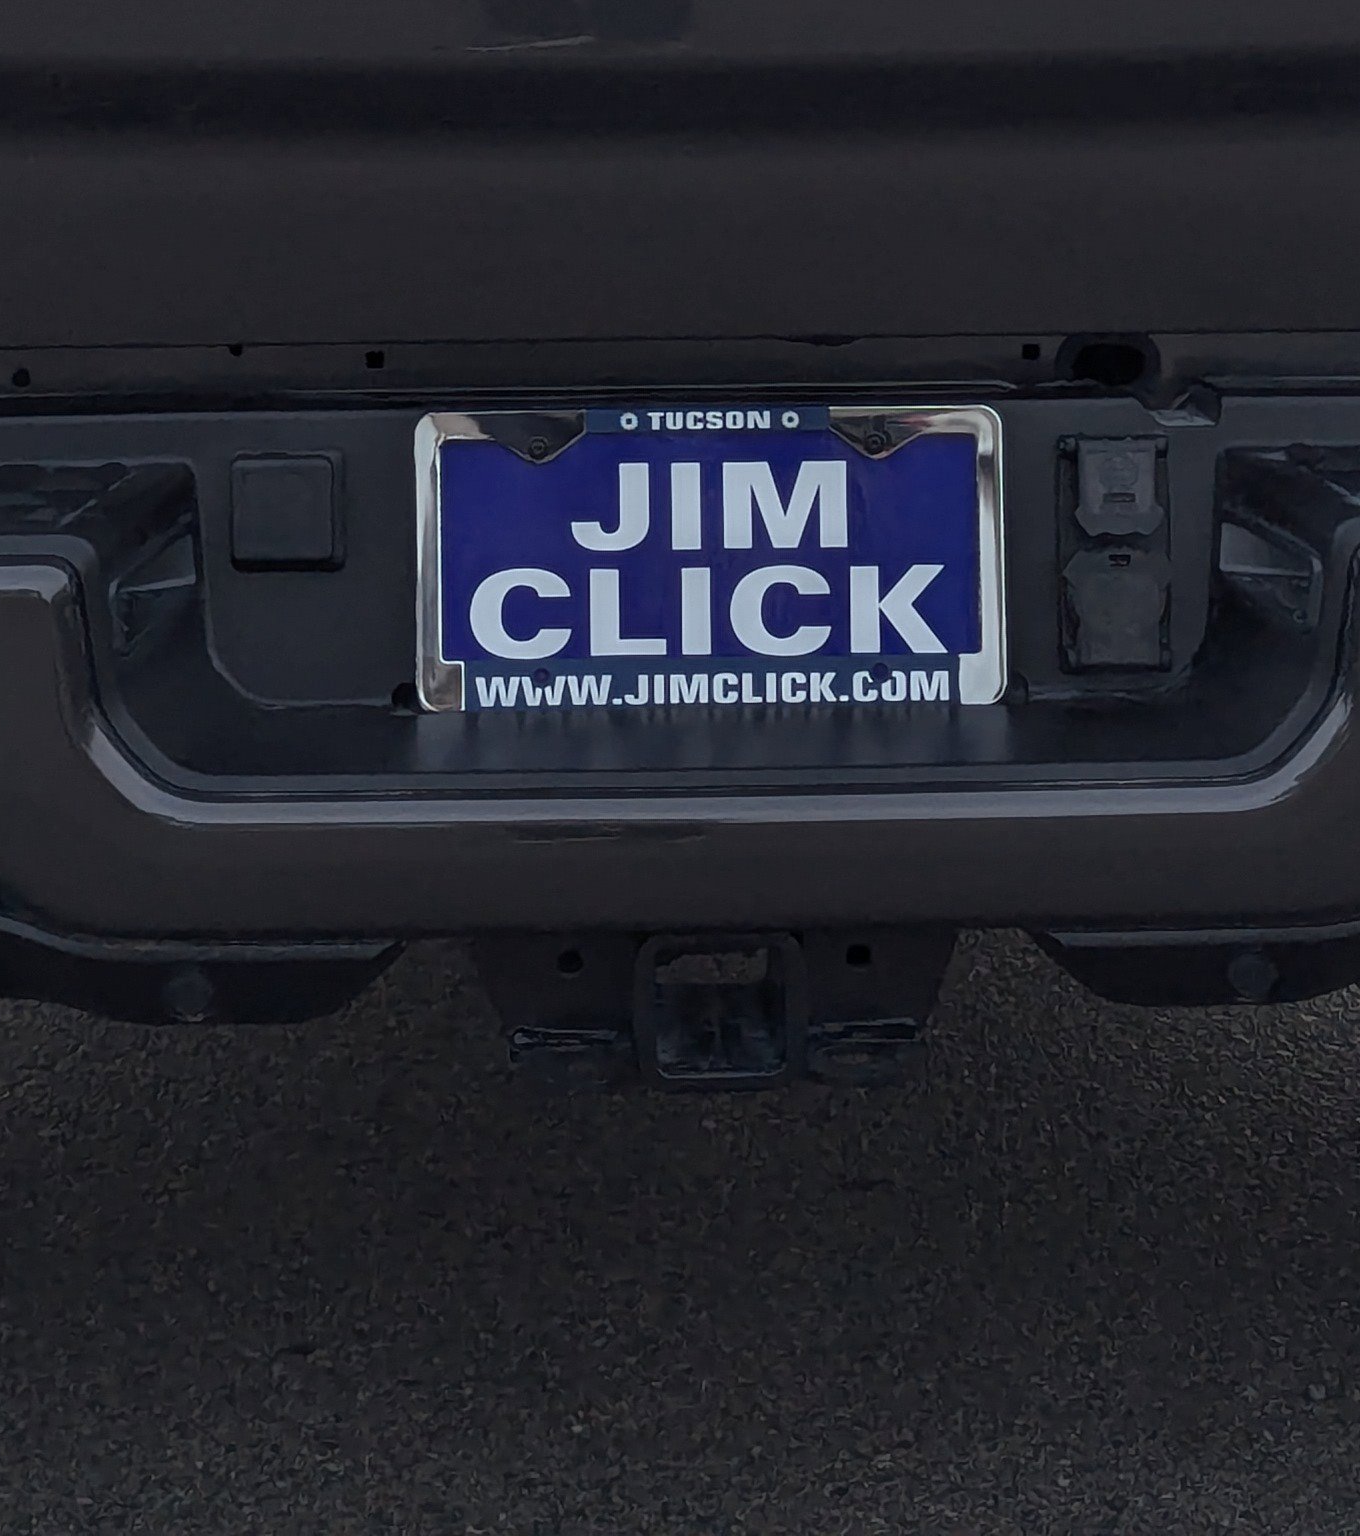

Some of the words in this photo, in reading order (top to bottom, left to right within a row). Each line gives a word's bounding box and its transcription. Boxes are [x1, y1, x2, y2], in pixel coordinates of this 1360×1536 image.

[647, 410, 771, 431] TUCSON
[571, 460, 849, 552] JIM
[468, 564, 949, 660] CLICK
[475, 670, 951, 708] WWW.JIMCLICK.COM
